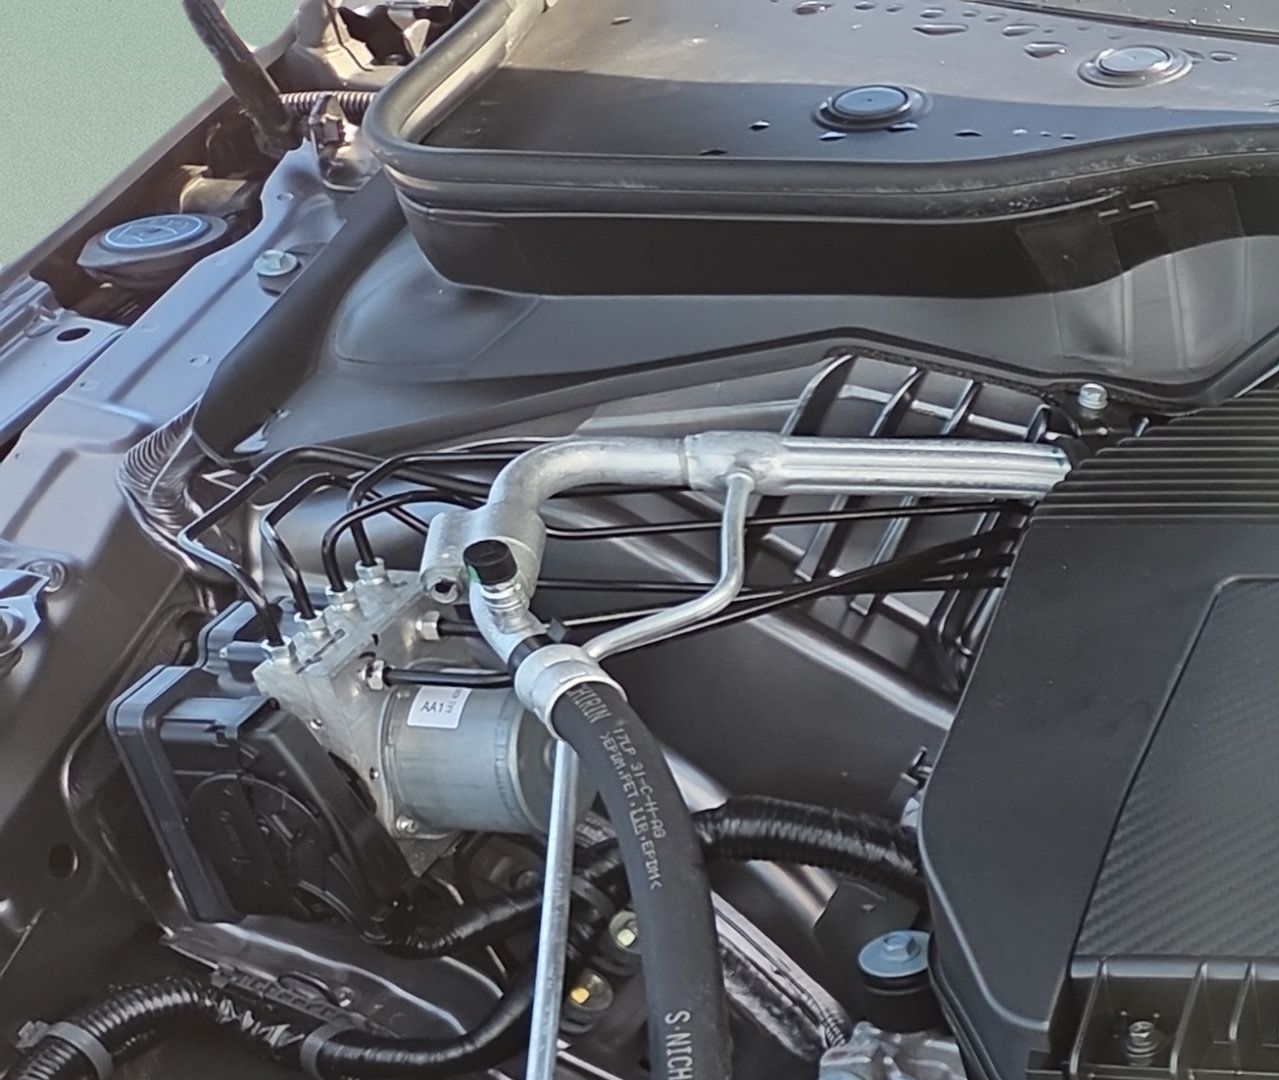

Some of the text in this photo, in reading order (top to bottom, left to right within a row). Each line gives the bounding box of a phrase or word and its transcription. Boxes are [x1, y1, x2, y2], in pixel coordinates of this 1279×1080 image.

[420, 701, 444, 713] AA1
[565, 683, 612, 723] HIRIN
[613, 727, 637, 756] 17LP
